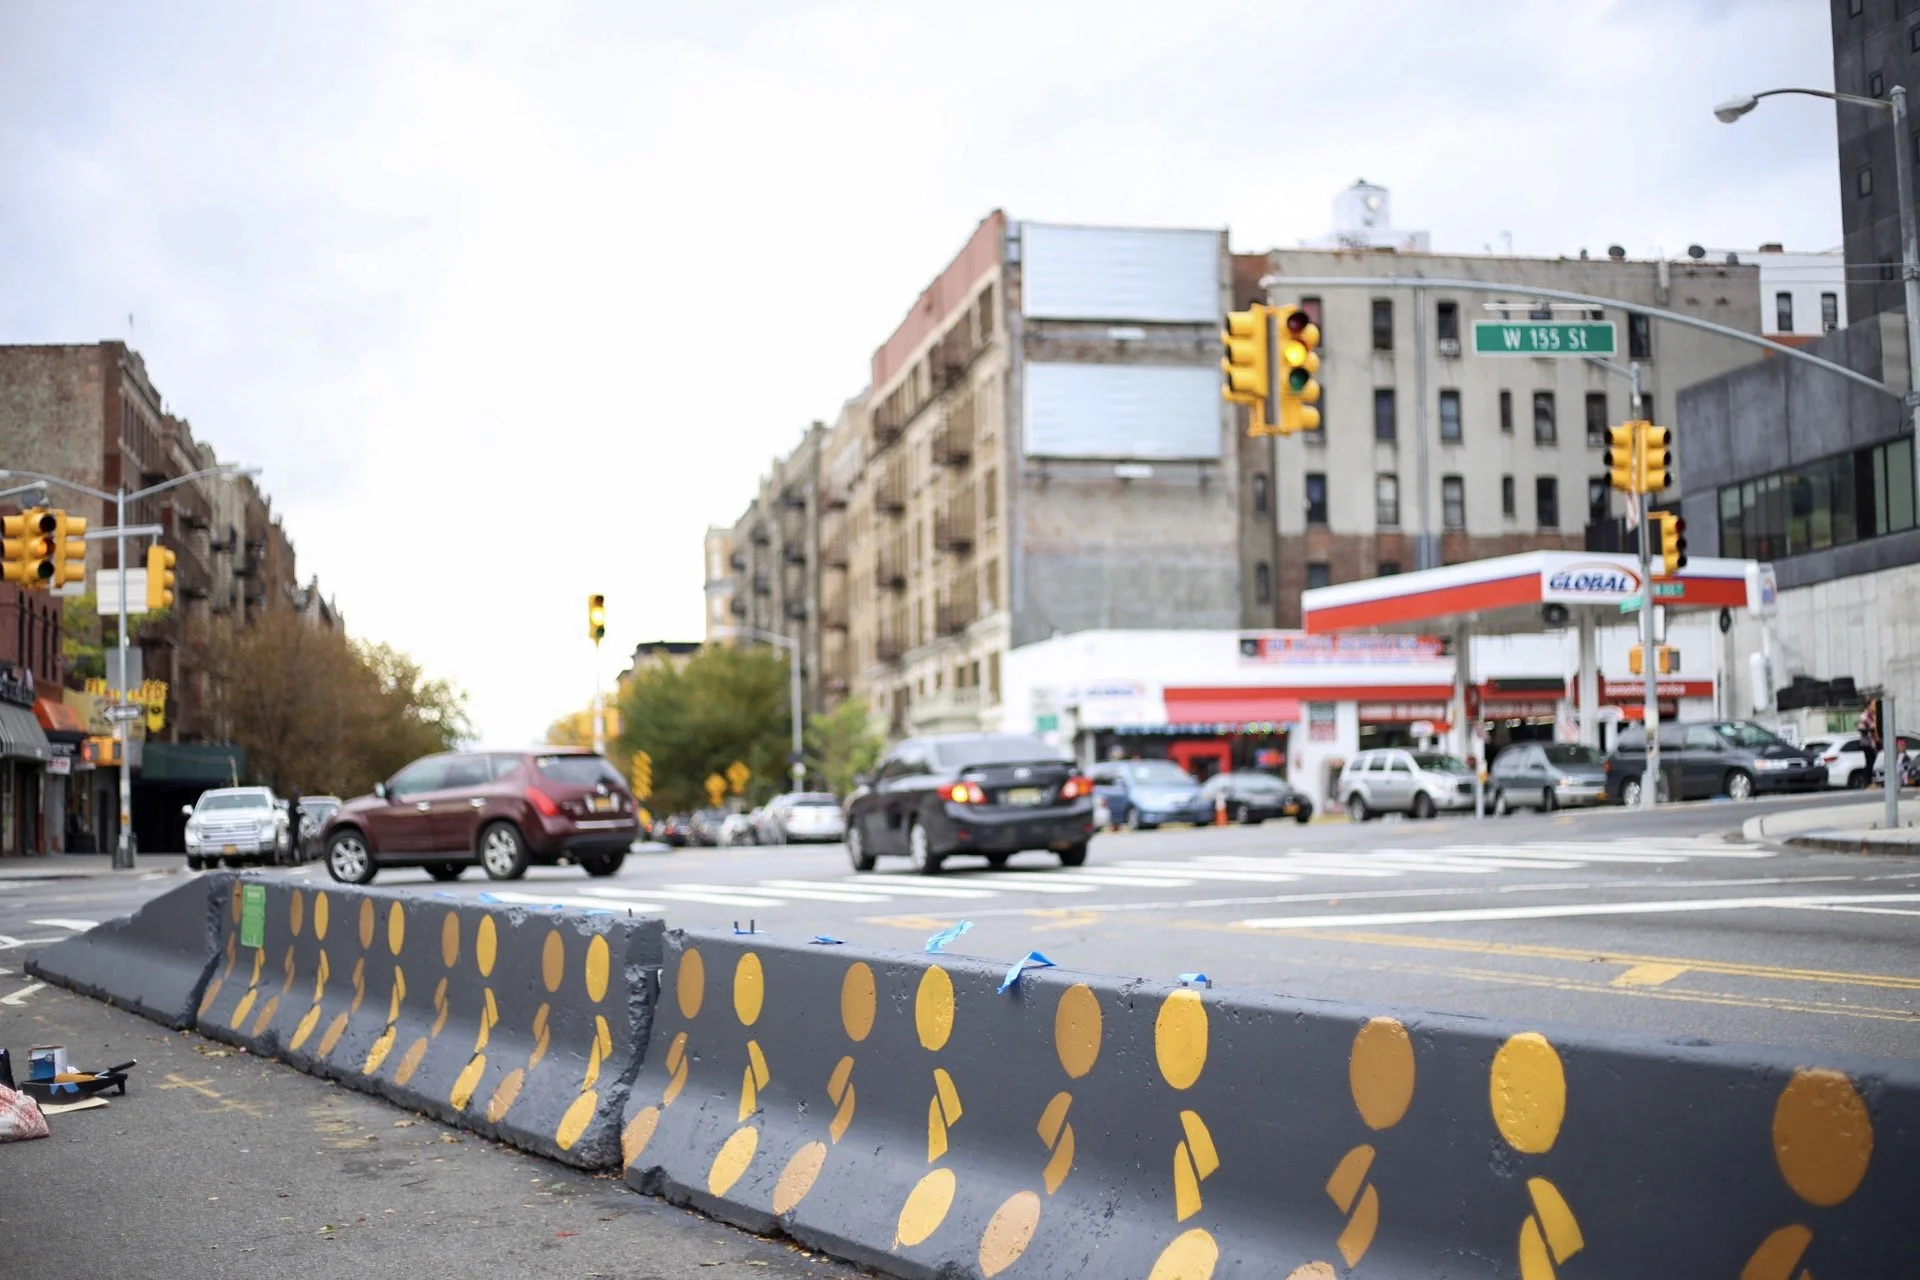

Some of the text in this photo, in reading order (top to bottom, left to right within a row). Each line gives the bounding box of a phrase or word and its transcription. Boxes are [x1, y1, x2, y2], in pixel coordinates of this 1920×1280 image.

[1502, 327, 1588, 350] W 155 St
[1550, 573, 1628, 593] GLOBAL
